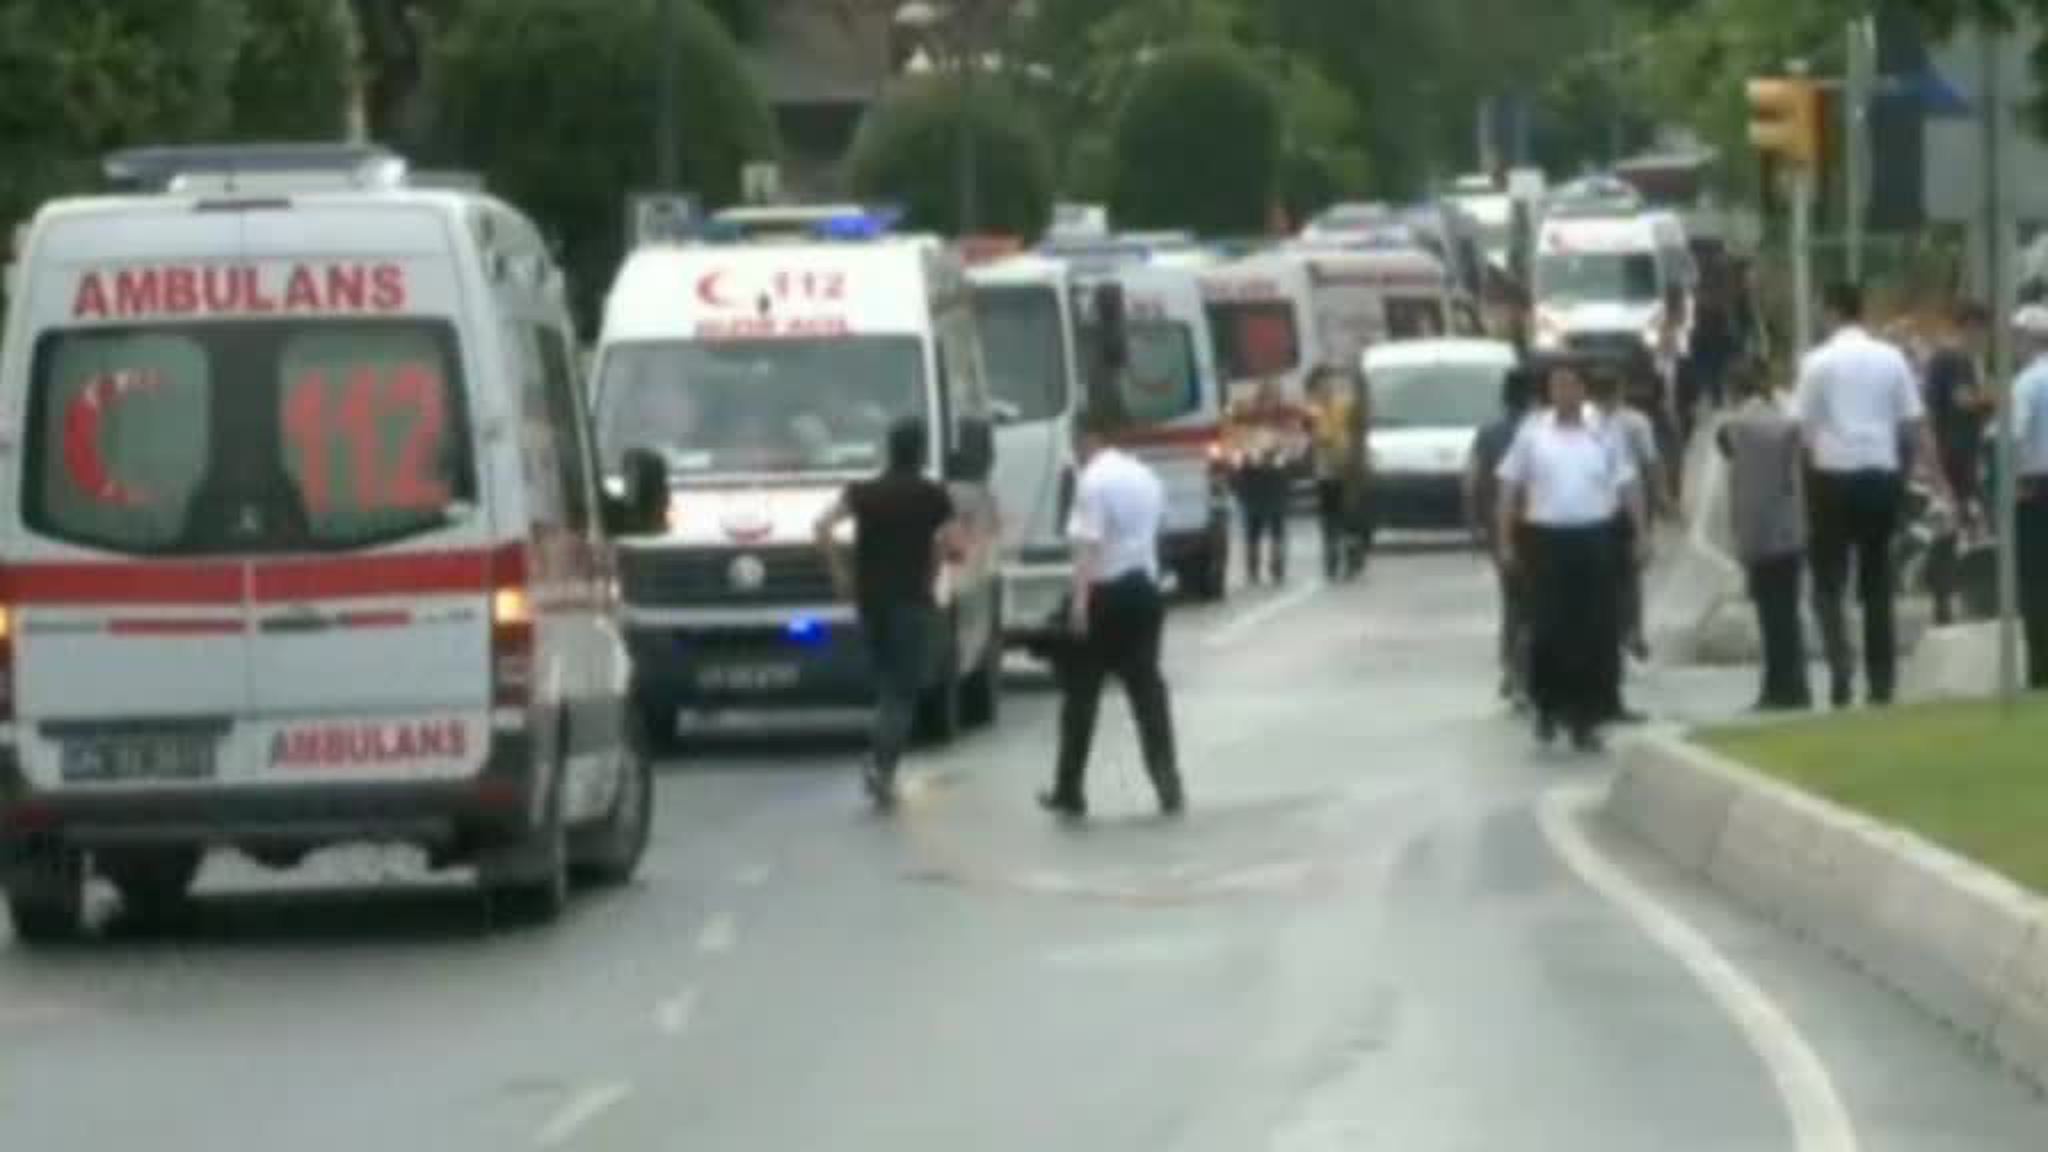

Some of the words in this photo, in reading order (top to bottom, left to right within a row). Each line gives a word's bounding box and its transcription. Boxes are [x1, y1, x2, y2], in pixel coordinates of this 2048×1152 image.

[73, 264, 407, 316] AMBULANS
[770, 271, 846, 301] 112
[281, 362, 447, 513] 112
[268, 718, 468, 768] AMBULANS
